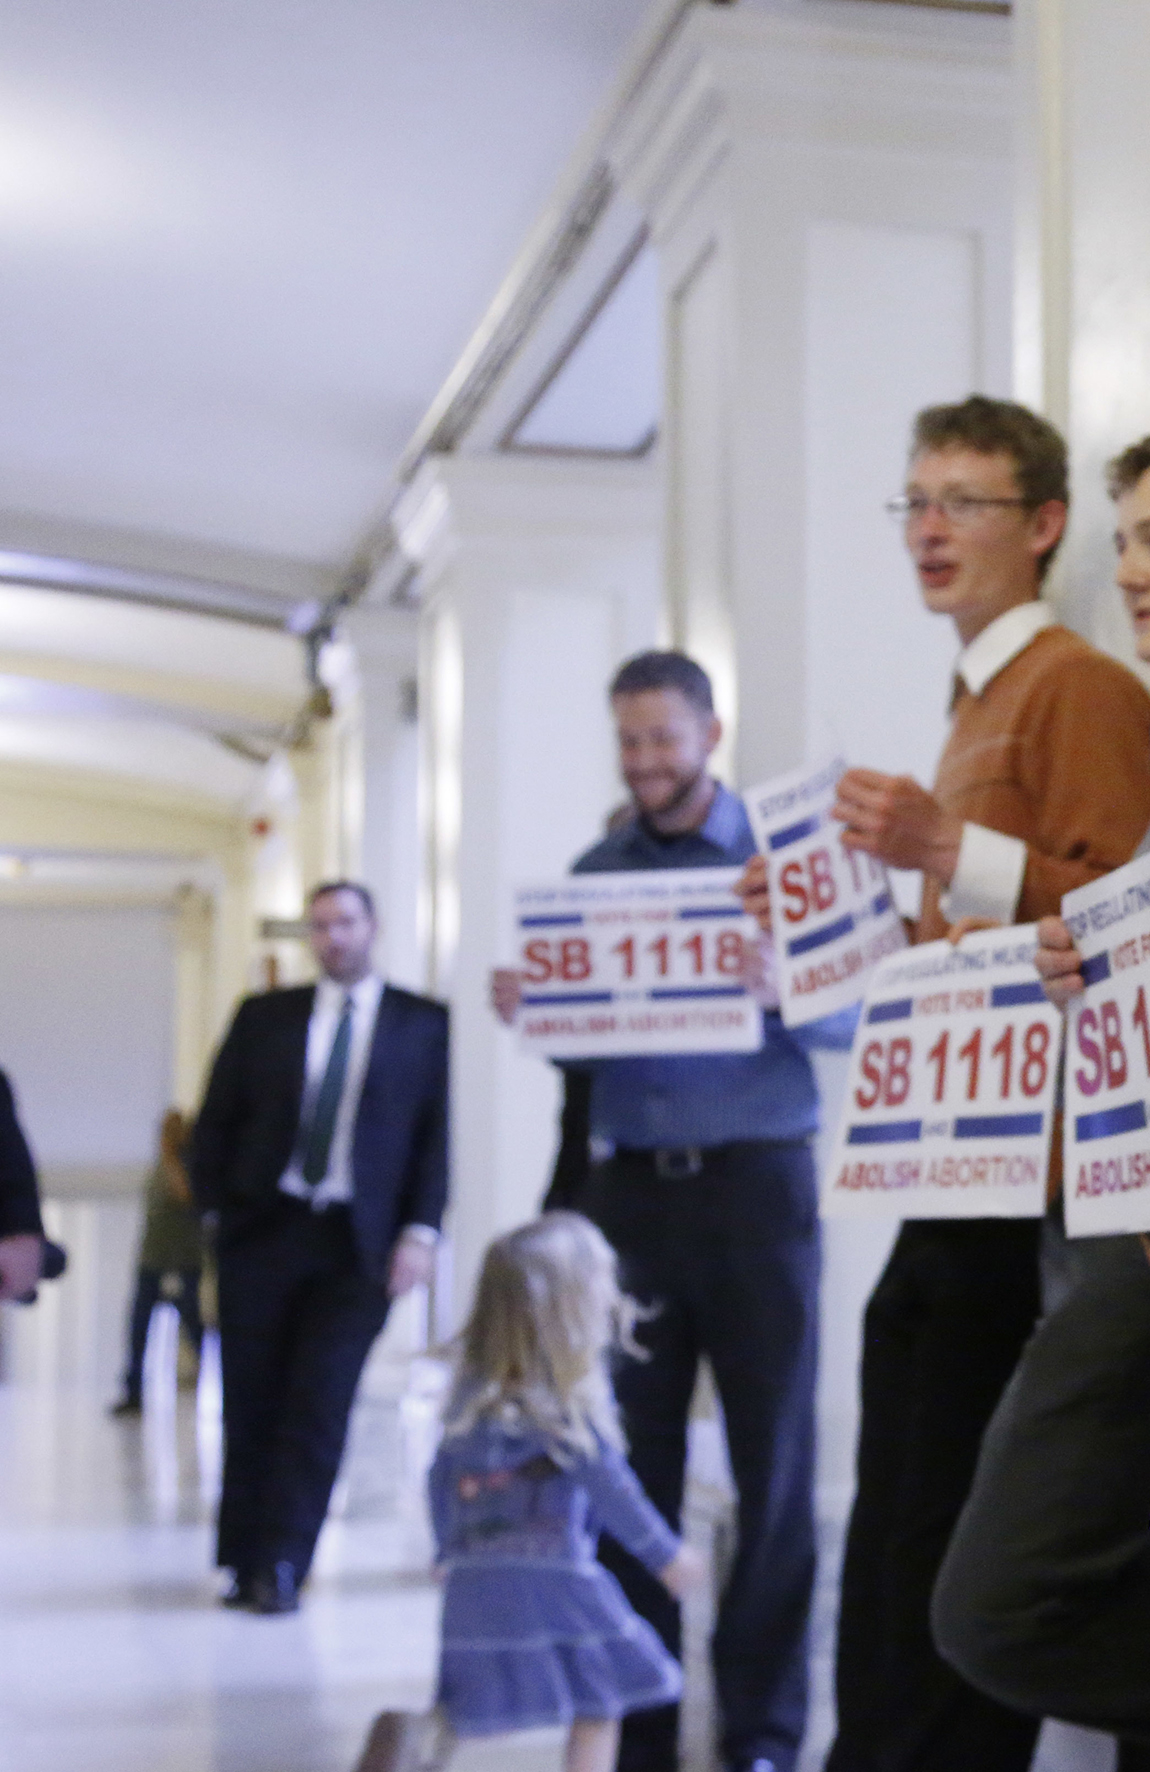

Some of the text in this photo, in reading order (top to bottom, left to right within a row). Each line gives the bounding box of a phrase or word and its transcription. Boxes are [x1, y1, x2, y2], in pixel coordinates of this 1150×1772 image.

[779, 846, 838, 923] SB
[522, 929, 748, 984] SB 1118
[854, 1022, 1050, 1110] SB 1118
[1075, 1000, 1128, 1097] SB
